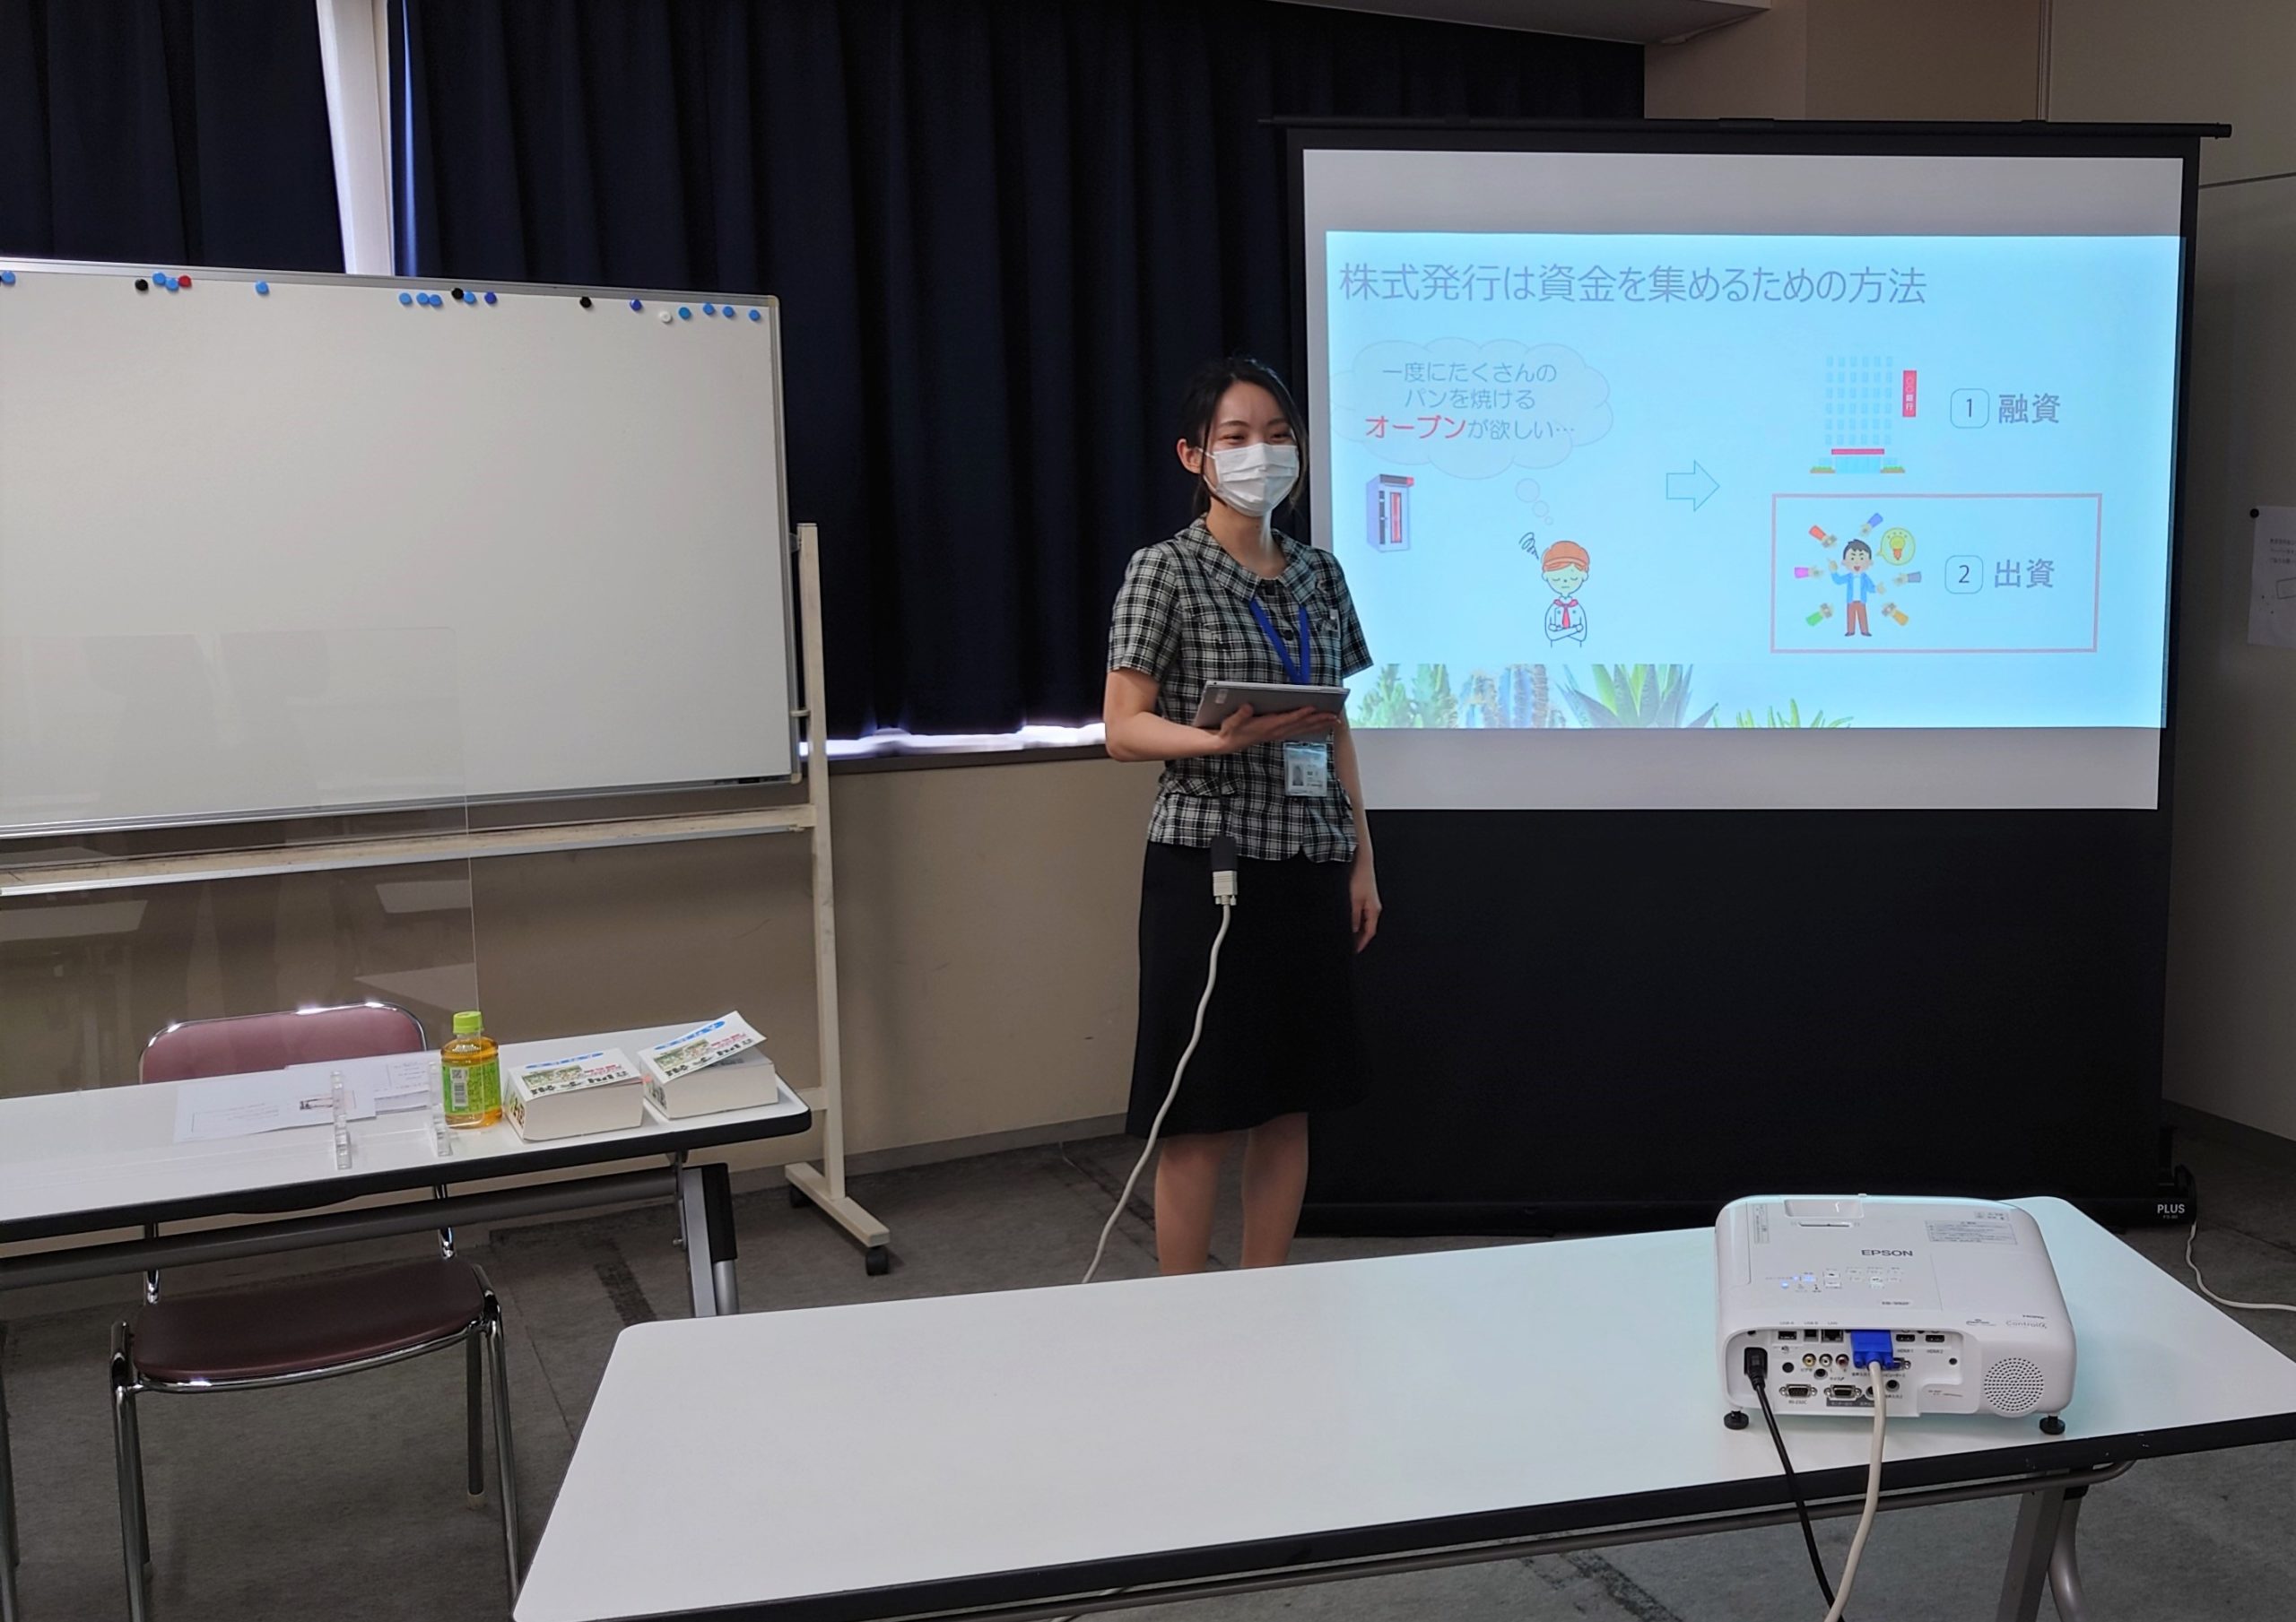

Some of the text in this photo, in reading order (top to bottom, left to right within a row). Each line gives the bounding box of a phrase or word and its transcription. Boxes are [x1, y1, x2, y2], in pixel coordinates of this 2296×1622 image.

[1339, 262, 1927, 303] 株式発行は資金を集めるための方法
[1382, 362, 1557, 383] 一度にたくさんの
[1405, 389, 1535, 409] パンを焼ける
[1966, 393, 2060, 423] 1 融資
[1958, 558, 2055, 588] 2 出資
[2157, 1203, 2186, 1214] PLUS
